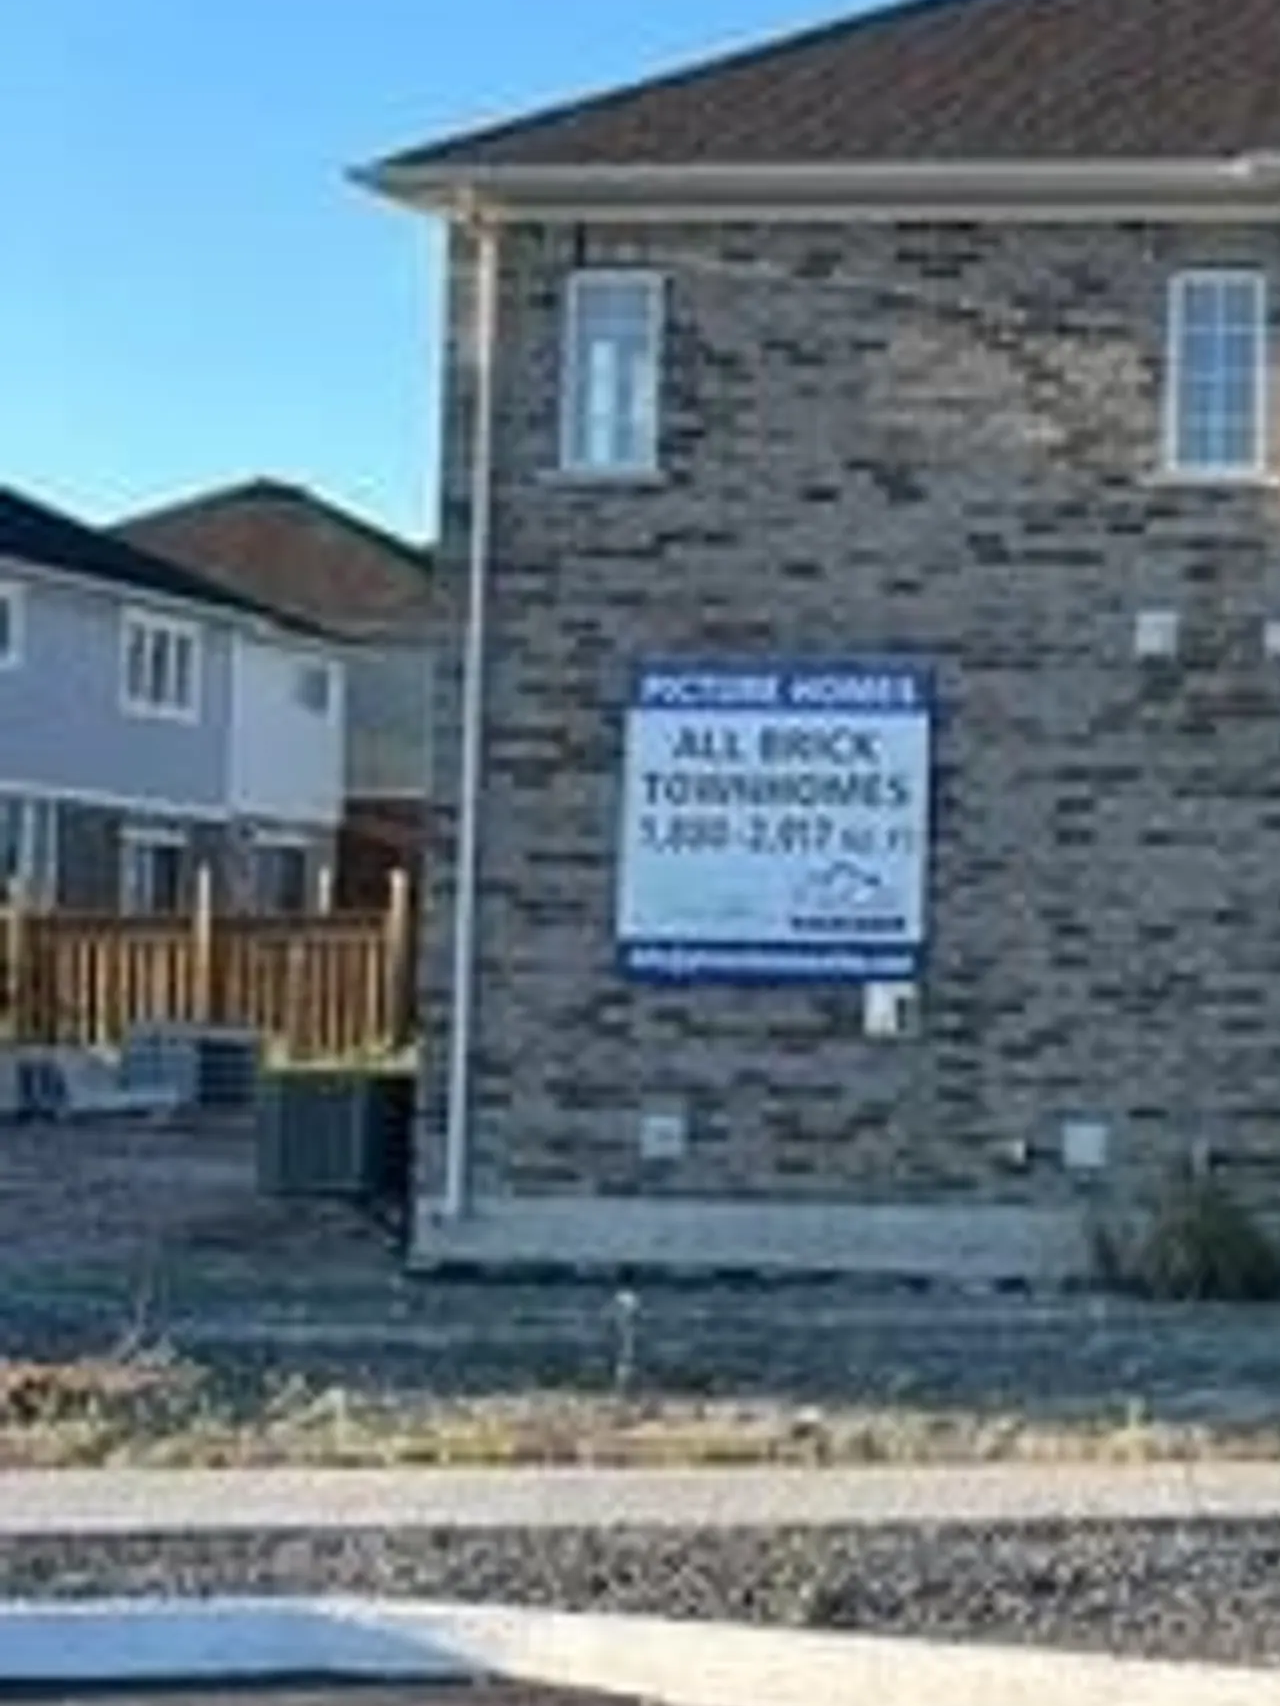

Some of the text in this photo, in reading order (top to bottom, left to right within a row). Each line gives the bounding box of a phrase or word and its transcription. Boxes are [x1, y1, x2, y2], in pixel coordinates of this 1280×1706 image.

[671, 727, 881, 763] ALL BRICK
[643, 773, 909, 806] TOWNHOMES
